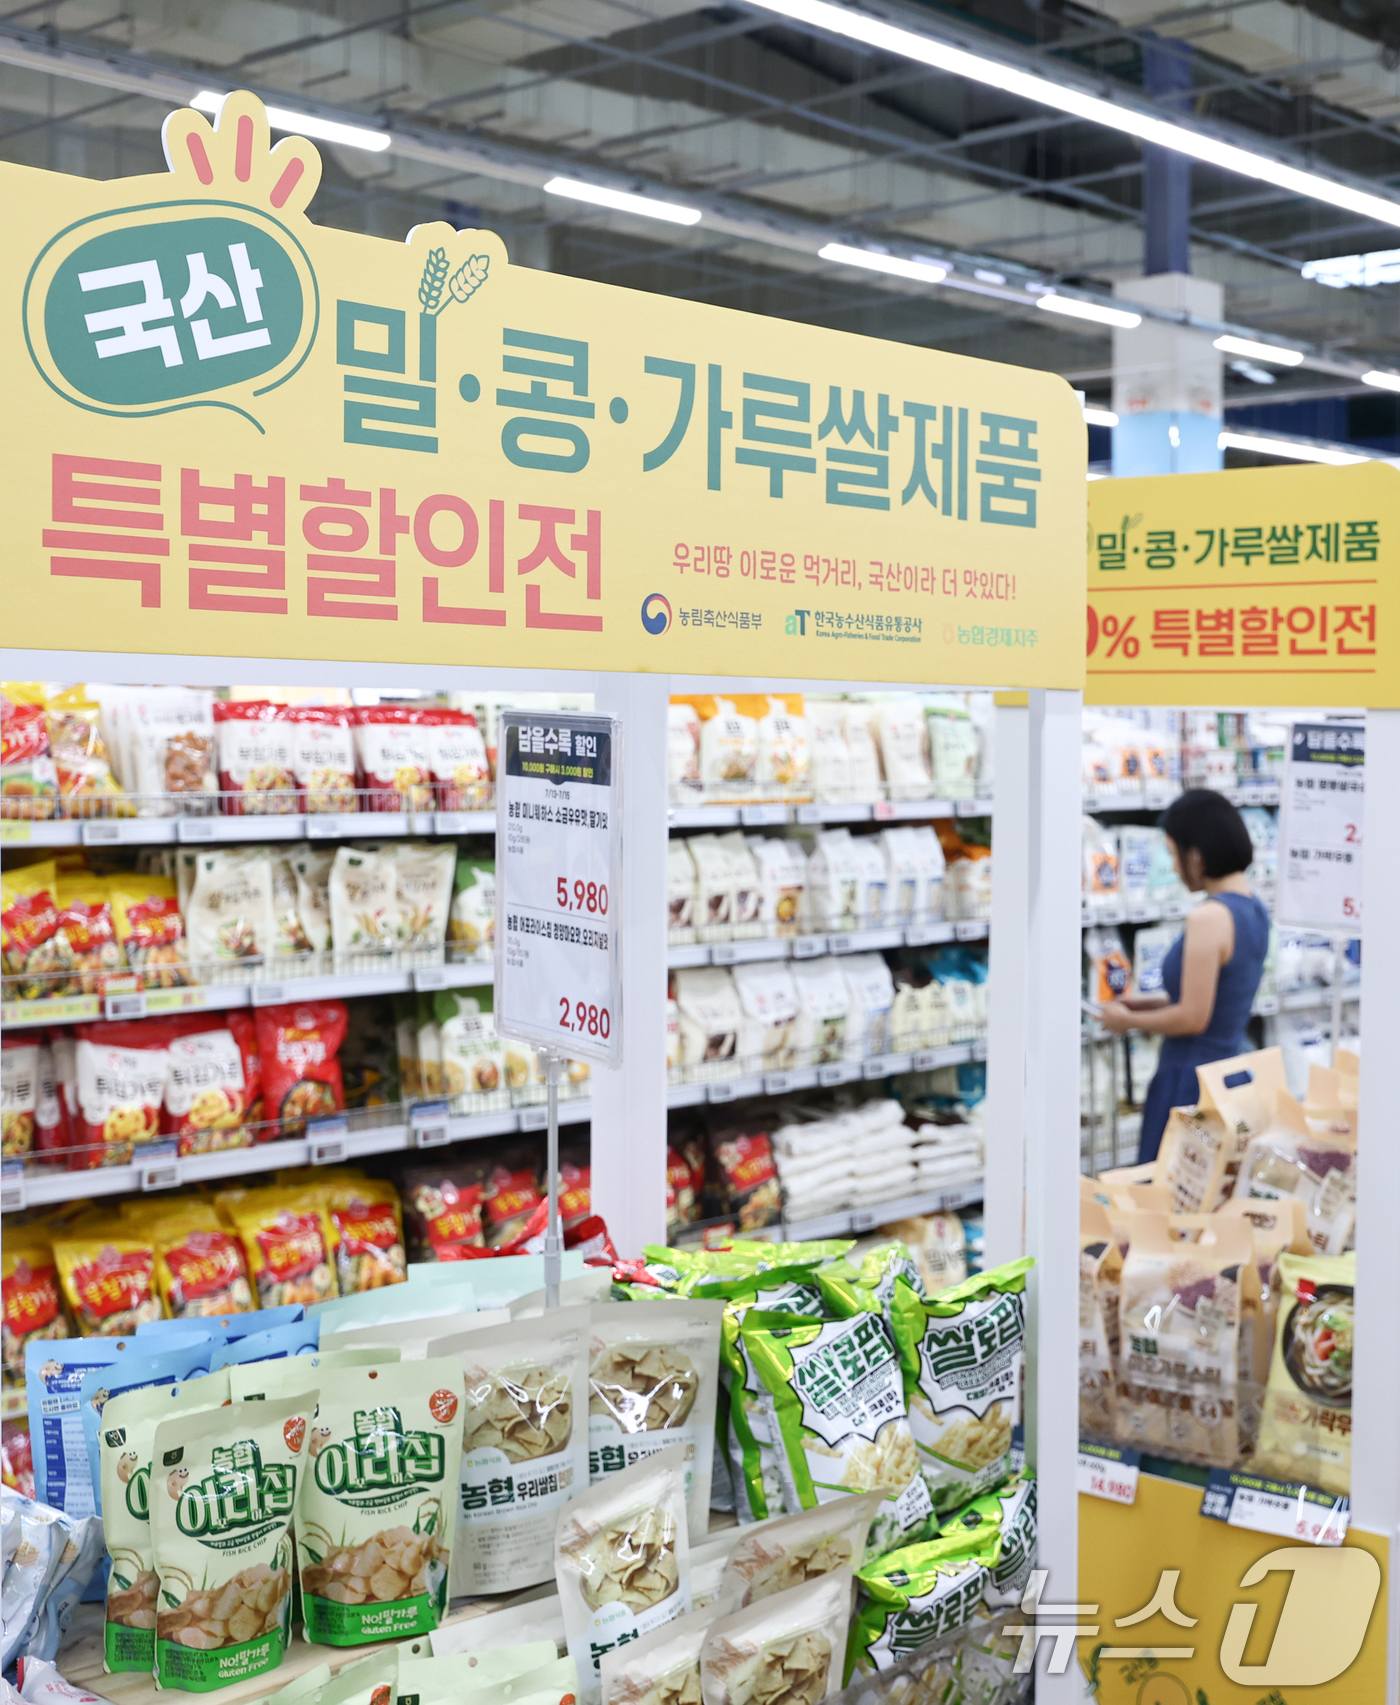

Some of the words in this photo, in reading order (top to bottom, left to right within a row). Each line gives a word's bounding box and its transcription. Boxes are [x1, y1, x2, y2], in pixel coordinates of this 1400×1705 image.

[78, 243, 271, 367] 국산
[42, 453, 603, 632] 특별할인전
[673, 542, 733, 578] 우리땅
[740, 550, 796, 584] 이로운
[804, 554, 862, 591] 먹거리,
[869, 561, 936, 595] 국산이라
[942, 568, 957, 597] 더
[963, 569, 1016, 601] 맛있다!
[679, 607, 762, 630] 농림축산식품부
[784, 609, 811, 636] aT
[815, 610, 922, 633] 한국농수산식품유통공사
[1151, 605, 1377, 656] 특별할인전
[957, 625, 1039, 648] 농협경제지주
[518, 725, 571, 756] 담을수록
[575, 734, 597, 758] 할인
[557, 876, 608, 915] 5,980
[559, 997, 610, 1039] 2,980
[354, 1408, 397, 1436] 농협
[213, 1442, 254, 1471] 농협
[461, 1476, 515, 1511] 농협
[517, 1473, 558, 1501] 우리쌀칩
[1090, 1476, 1135, 1499] 14,980
[360, 1507, 376, 1516] FISH
[377, 1506, 392, 1515] RICE
[394, 1500, 409, 1511] CHIP
[222, 1548, 237, 1557] FISH
[238, 1546, 252, 1555] RICE
[253, 1536, 268, 1549] CHIP
[361, 1624, 392, 1635] Gluten
[393, 1619, 418, 1631] Free
[218, 1666, 247, 1679] Gluten
[248, 1656, 269, 1672] Free
